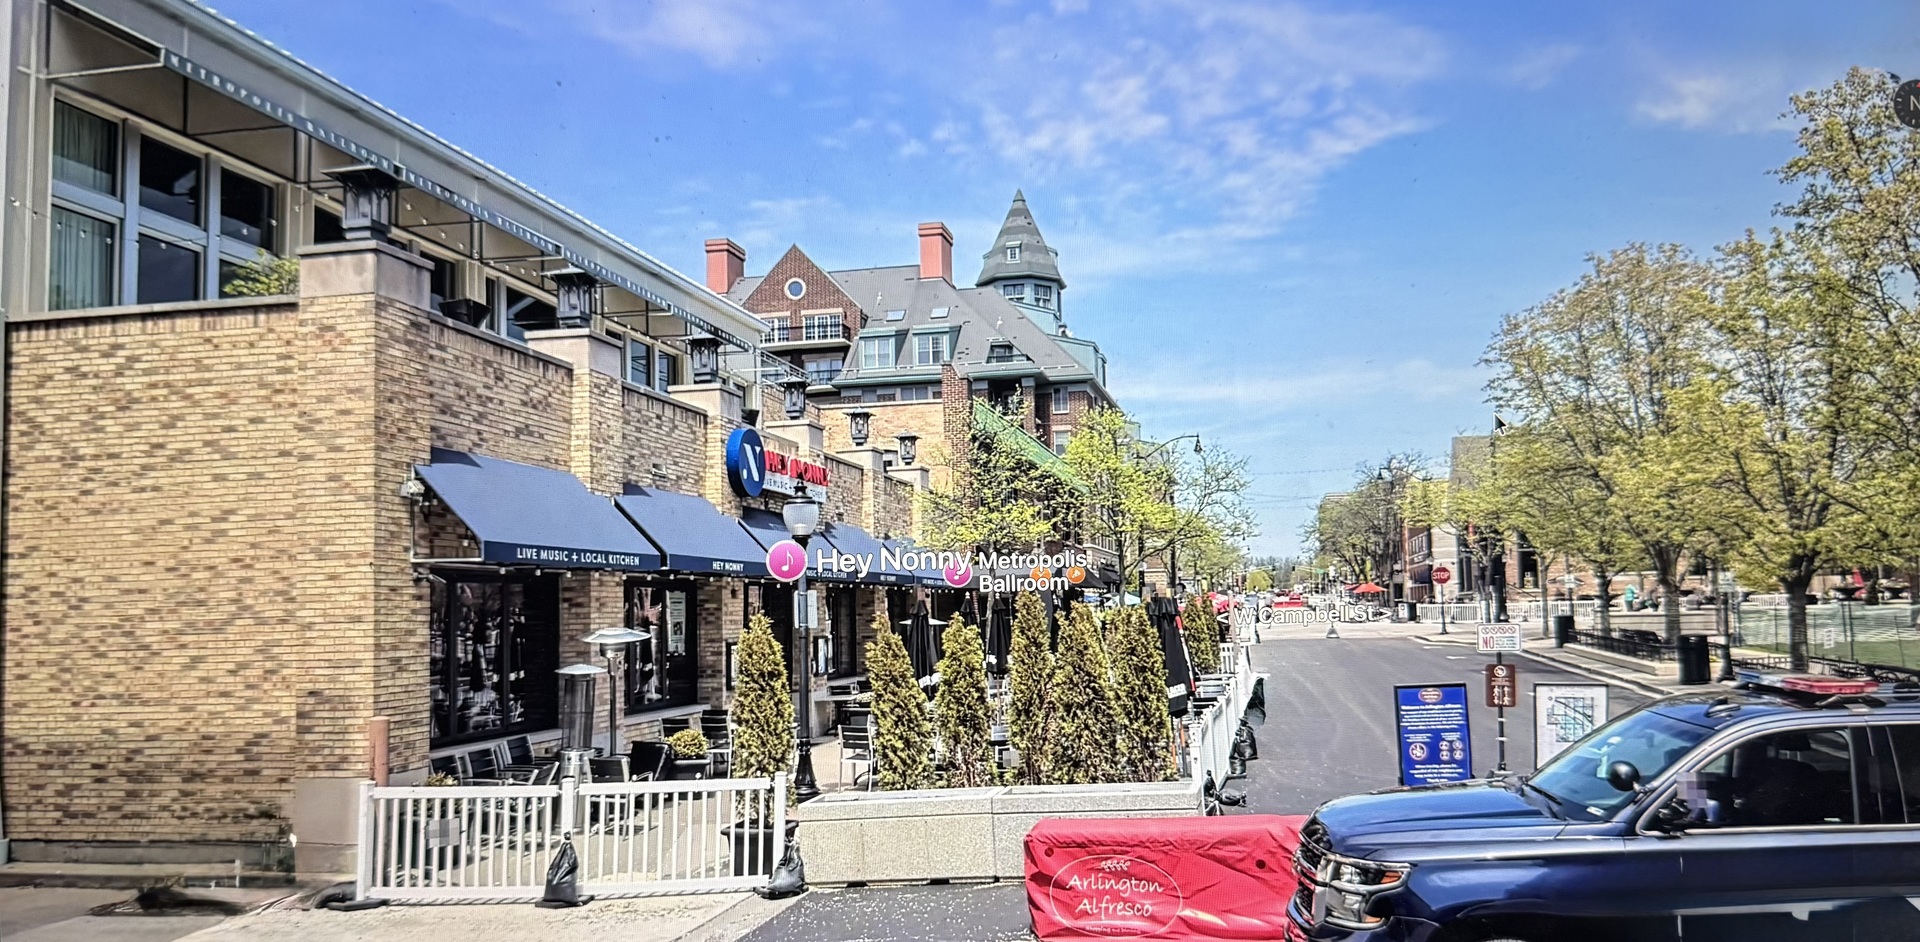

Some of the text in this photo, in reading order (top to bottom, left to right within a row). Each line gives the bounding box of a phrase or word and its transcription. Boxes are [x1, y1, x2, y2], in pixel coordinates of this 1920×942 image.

[169, 54, 295, 124] METROPOLIS
[765, 449, 790, 476] HEY
[517, 547, 538, 560] LIVE
[540, 548, 569, 562] MUSIC
[581, 552, 607, 564] LOCAL
[608, 553, 640, 566] KITCHEN
[712, 560, 744, 572] HEY NONNY
[1432, 571, 1450, 580] STOP
[1482, 635, 1495, 650] NO
[1065, 872, 1164, 897] Arlington
[1075, 895, 1152, 920] Alfresco
